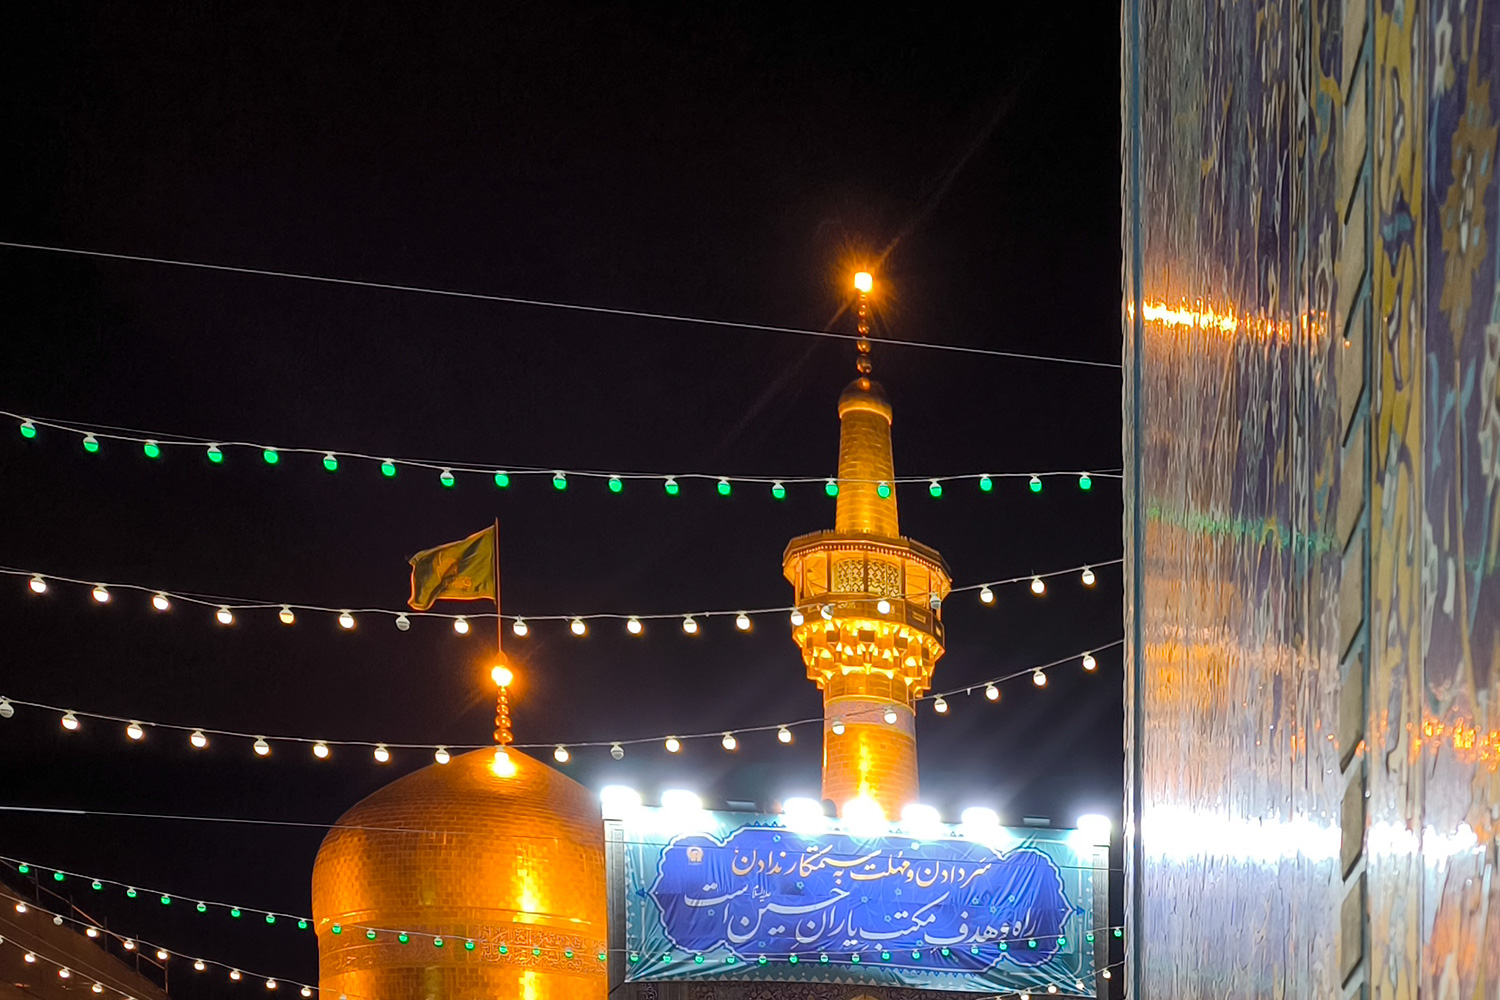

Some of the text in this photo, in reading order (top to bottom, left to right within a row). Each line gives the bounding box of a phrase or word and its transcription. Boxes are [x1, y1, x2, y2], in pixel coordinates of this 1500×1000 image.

[731, 847, 787, 876] ندادن
[915, 861, 965, 887] دادن
[832, 867, 847, 885] به
[905, 869, 914, 883] و
[684, 881, 749, 925] است
[726, 887, 851, 945] حسین
[998, 921, 1010, 940] و
[1012, 906, 1037, 938] راه
